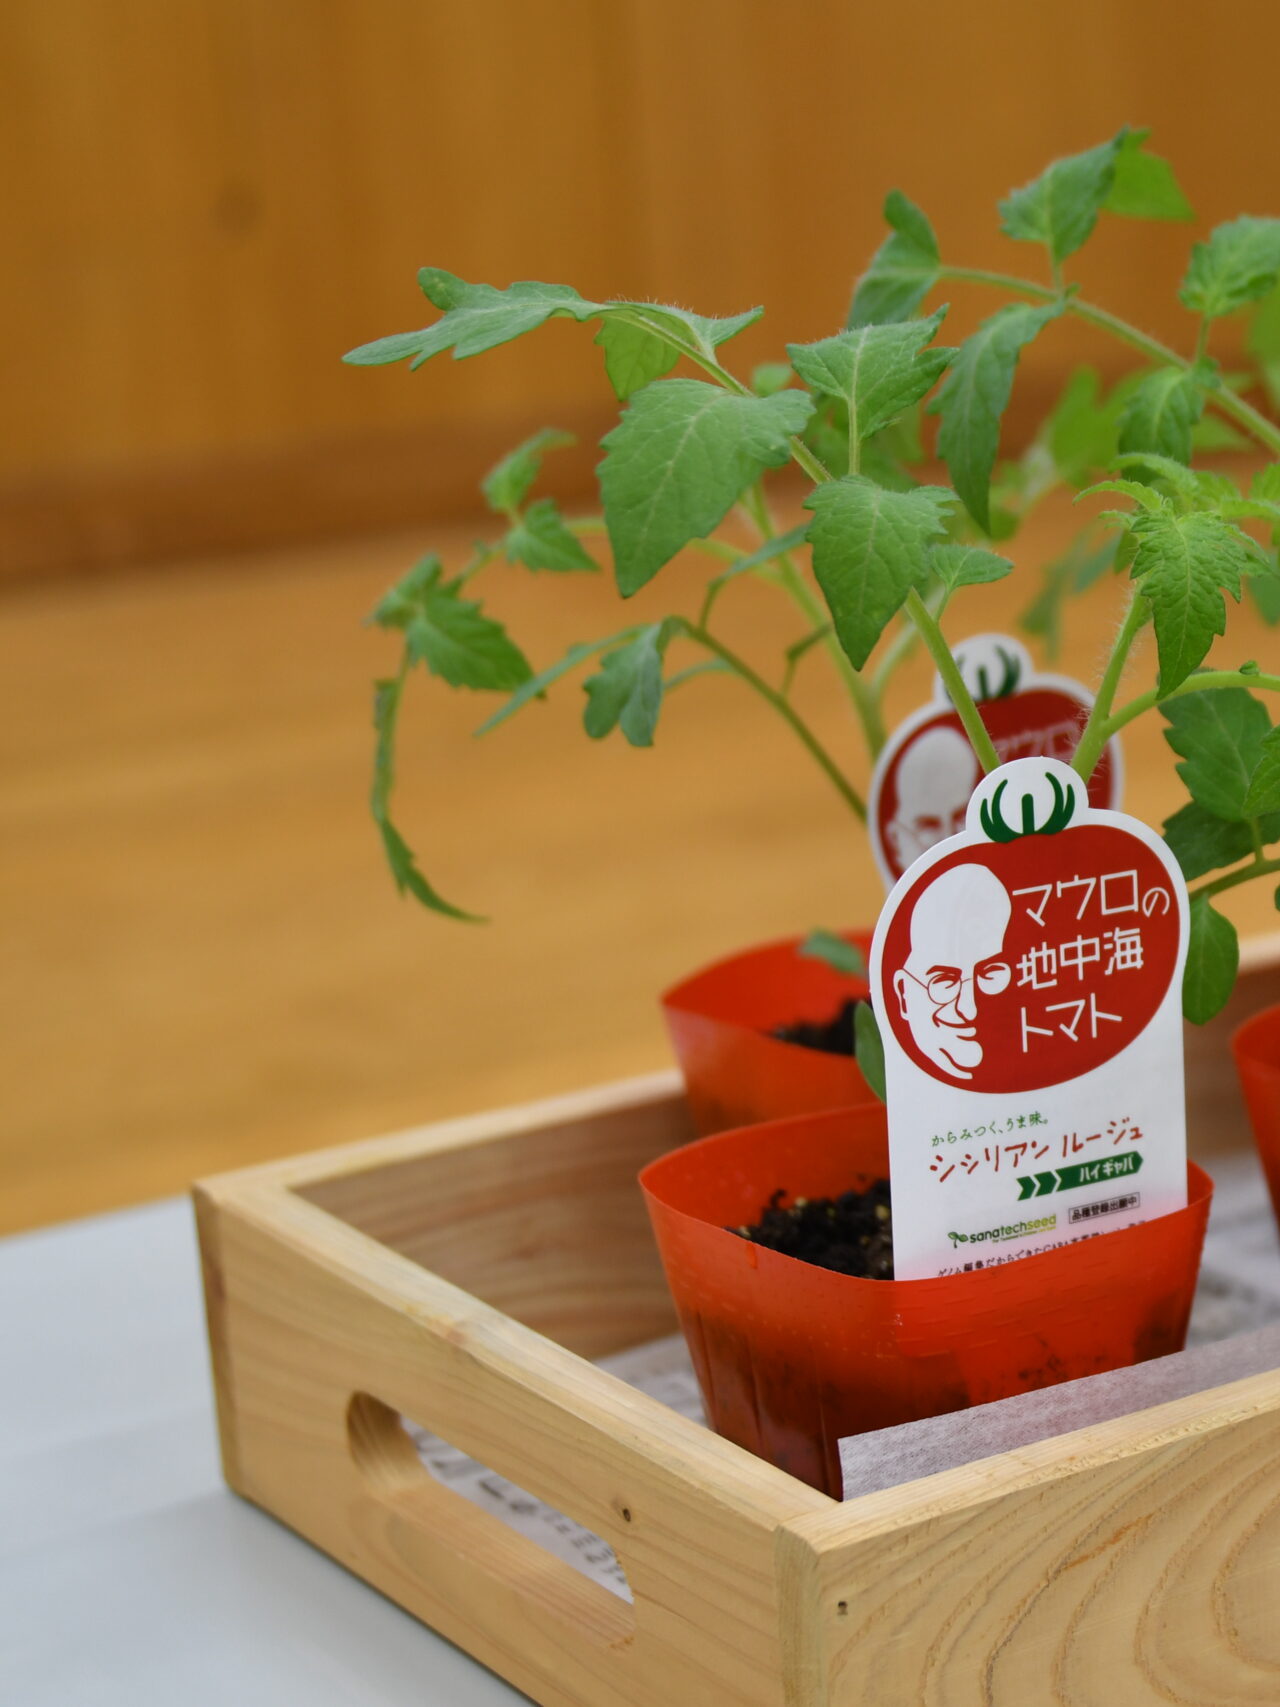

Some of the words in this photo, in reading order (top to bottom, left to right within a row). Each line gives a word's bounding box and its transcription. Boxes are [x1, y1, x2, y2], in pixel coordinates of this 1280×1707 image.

[1011, 868, 1171, 927] マウロの
[1015, 926, 1145, 990] 地中海
[1020, 992, 1123, 1053] トマト
[929, 1140, 1050, 1183] シシリアン
[1062, 1116, 1144, 1158] ルージュ
[930, 1110, 1049, 1147] からみつく、うま味。
[969, 1213, 1058, 1244] sanatechseed
